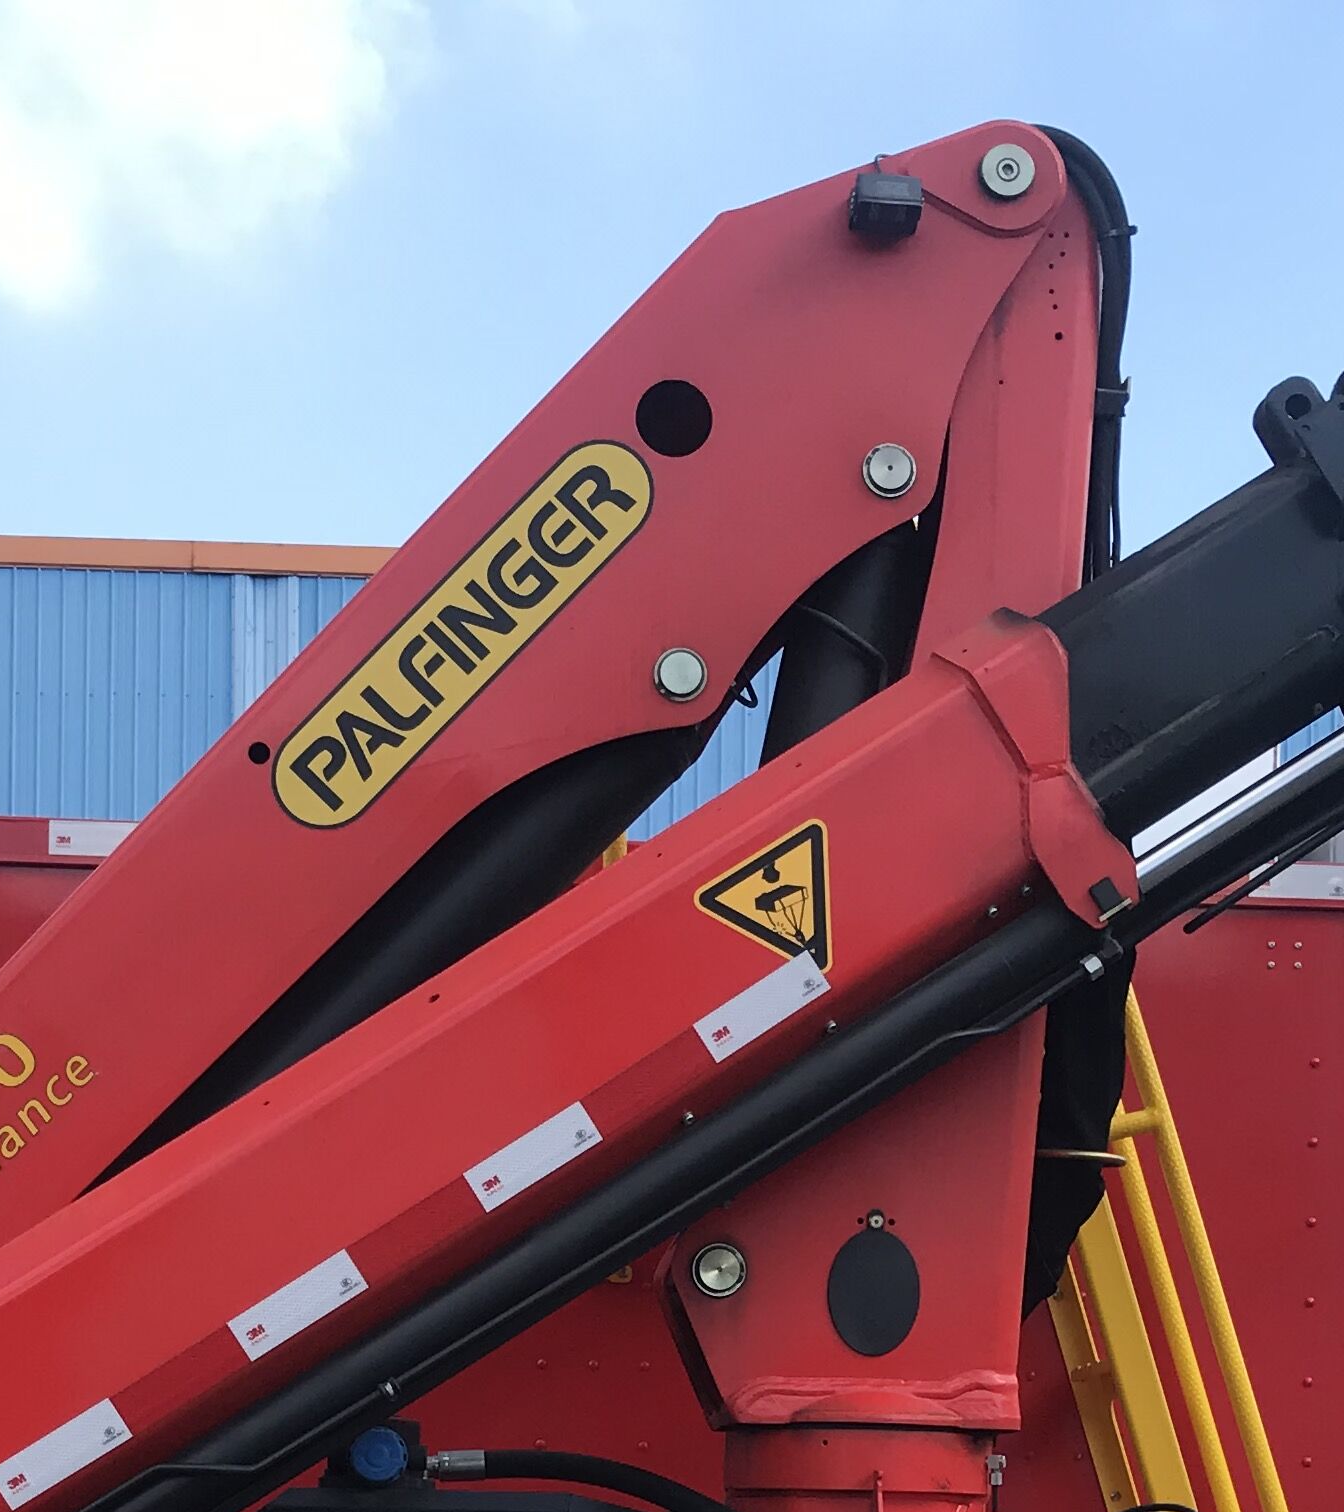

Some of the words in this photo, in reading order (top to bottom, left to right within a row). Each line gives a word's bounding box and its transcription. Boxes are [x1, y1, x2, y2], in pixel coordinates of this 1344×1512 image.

[290, 464, 637, 811] PALFINGER
[712, 1027, 730, 1042] 3M
[482, 1176, 501, 1191] 3M
[247, 1324, 266, 1340] 3M
[8, 1474, 27, 1489] 3M
